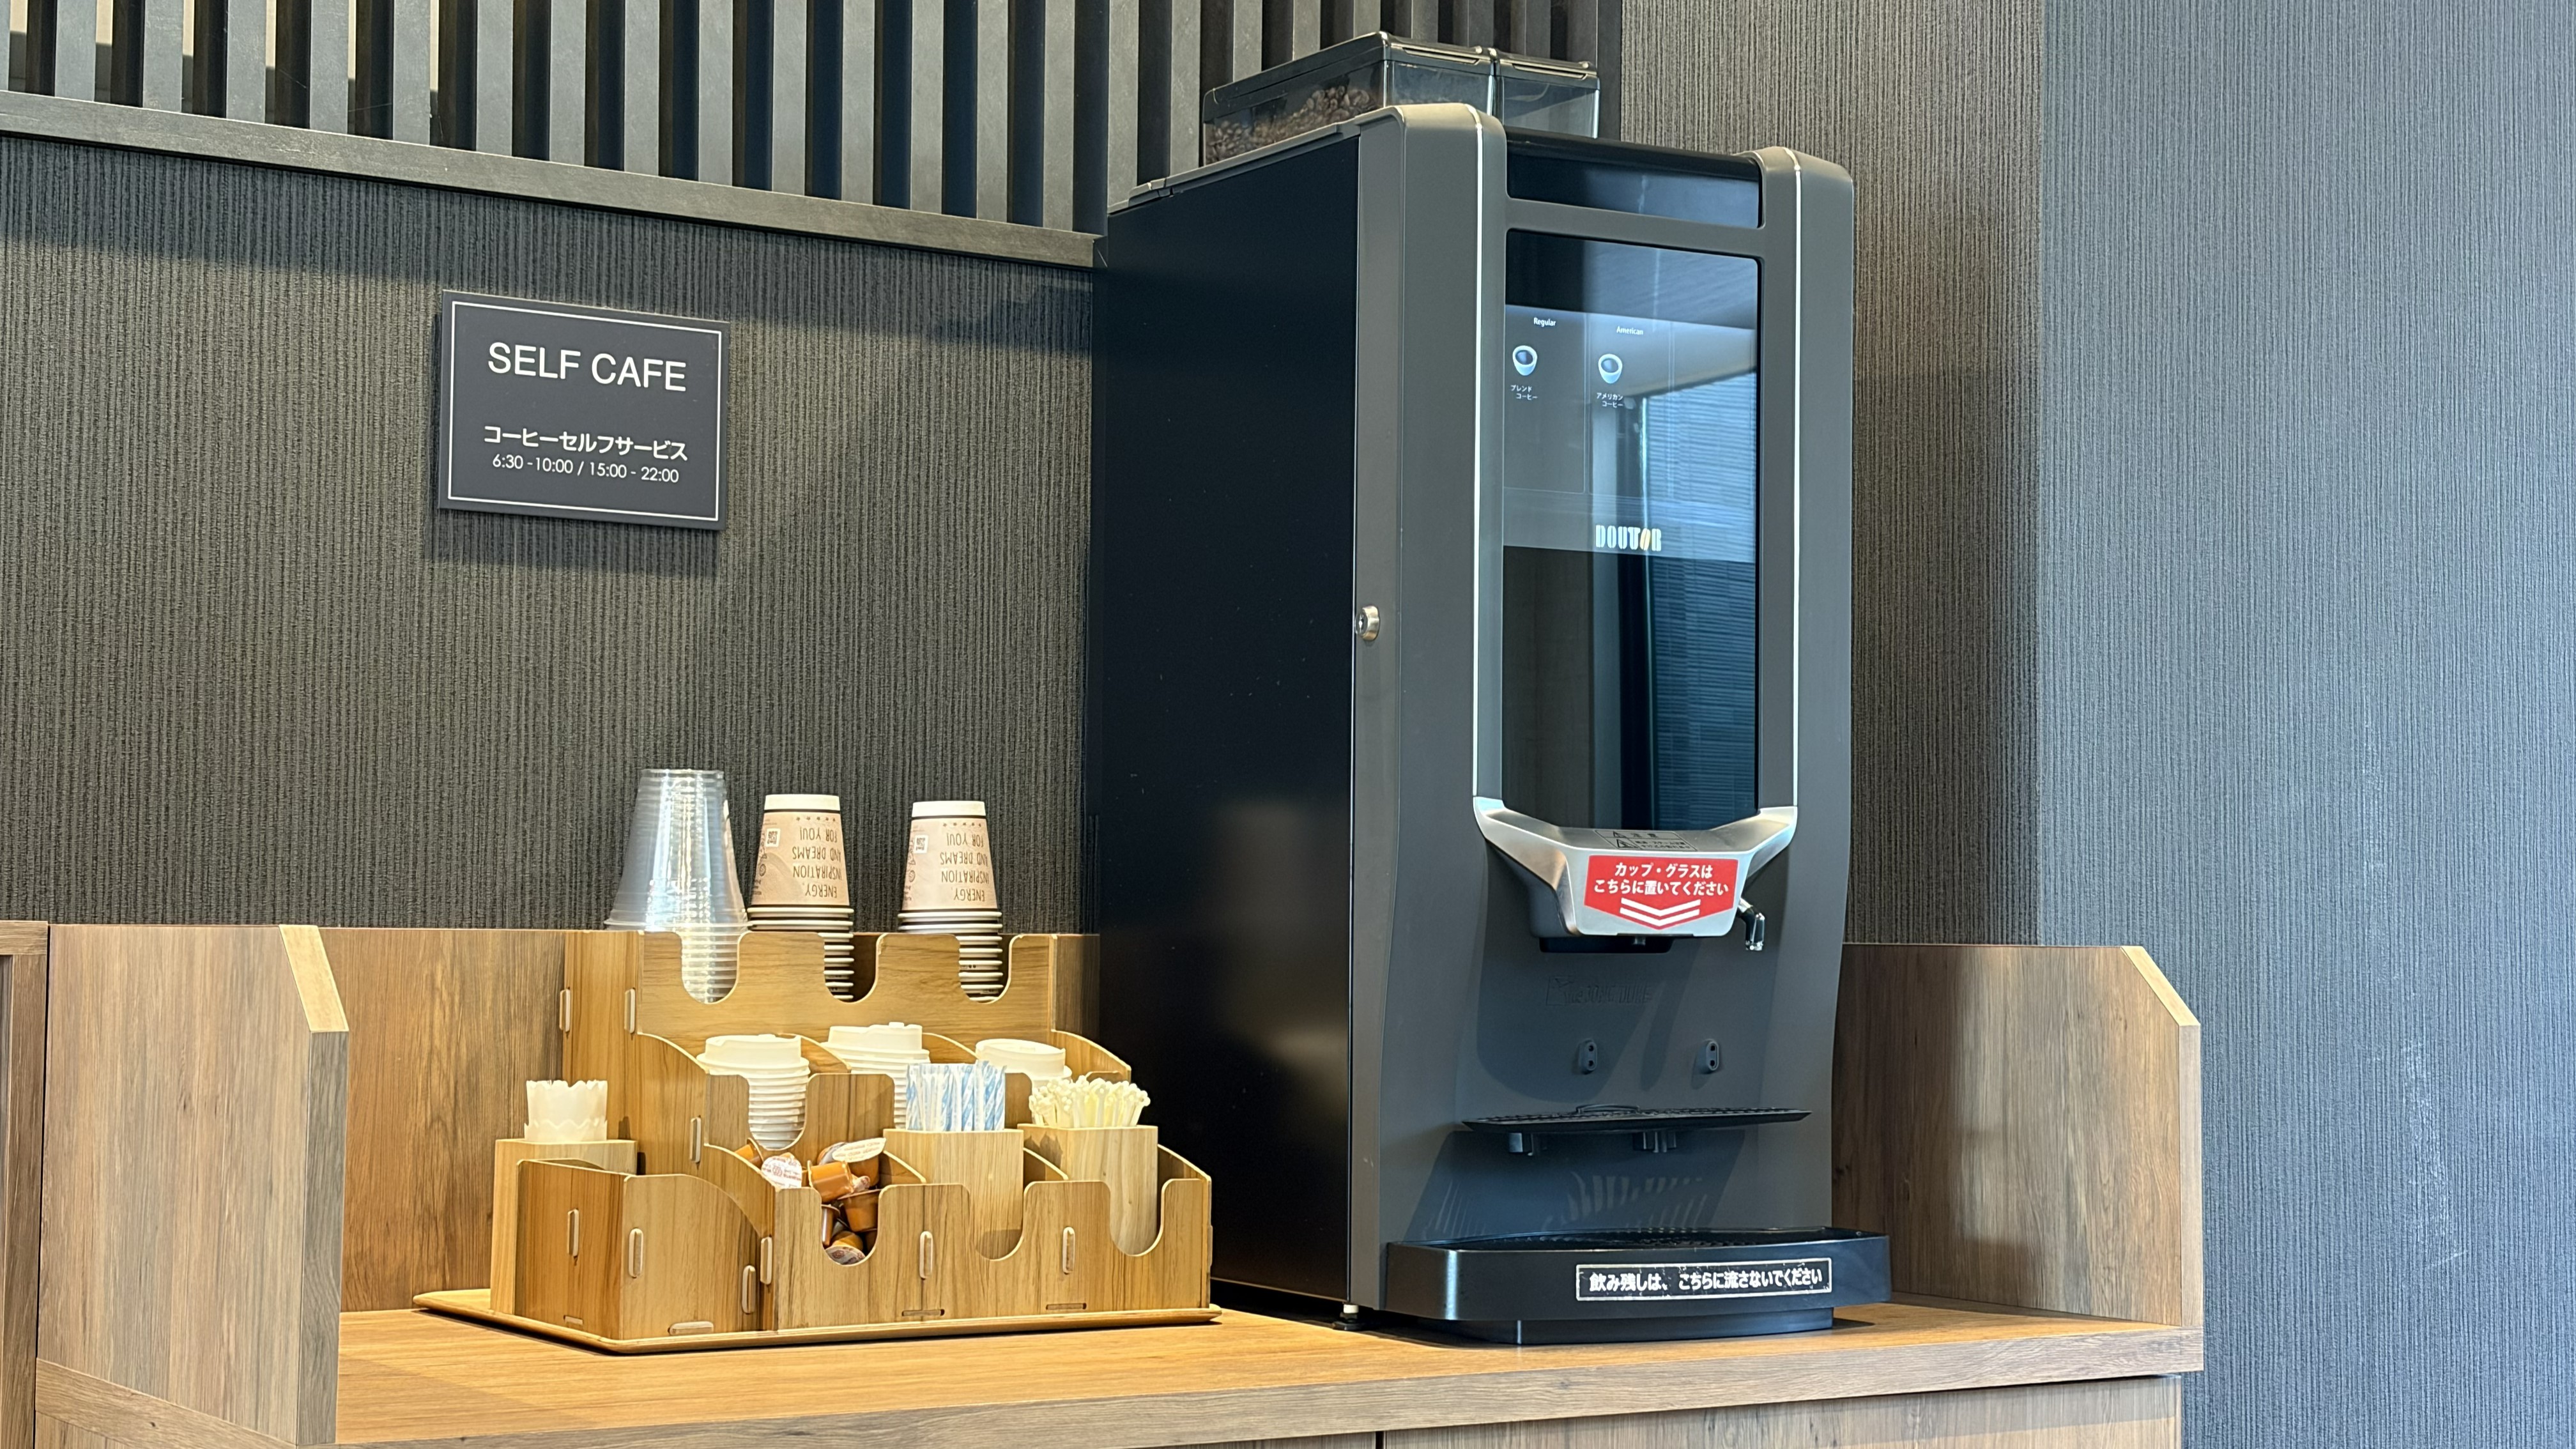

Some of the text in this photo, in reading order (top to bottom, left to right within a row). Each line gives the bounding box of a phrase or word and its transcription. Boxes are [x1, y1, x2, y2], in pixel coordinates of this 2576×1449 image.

[1533, 317, 1556, 326] Regular
[1616, 326, 1644, 335] American
[488, 341, 686, 392] SELF CAFE
[1597, 392, 1623, 401] アメリカン
[484, 425, 688, 461] コーヒーセルフサービス
[493, 454, 524, 470] 6:30
[590, 462, 627, 479] 15:00
[641, 466, 679, 483] 22:00
[1595, 525, 1661, 551] DOUTOR
[825, 829, 838, 843] FOR
[972, 834, 984, 848] FOR
[792, 846, 841, 862] AND DREAMS
[940, 852, 988, 867] AND DREAMS
[793, 865, 843, 880] INSPIRATION
[941, 870, 989, 884] INSPIRATION
[1614, 862, 1713, 879] カップ・グラスは
[1594, 879, 1729, 896] こちらに置いてください
